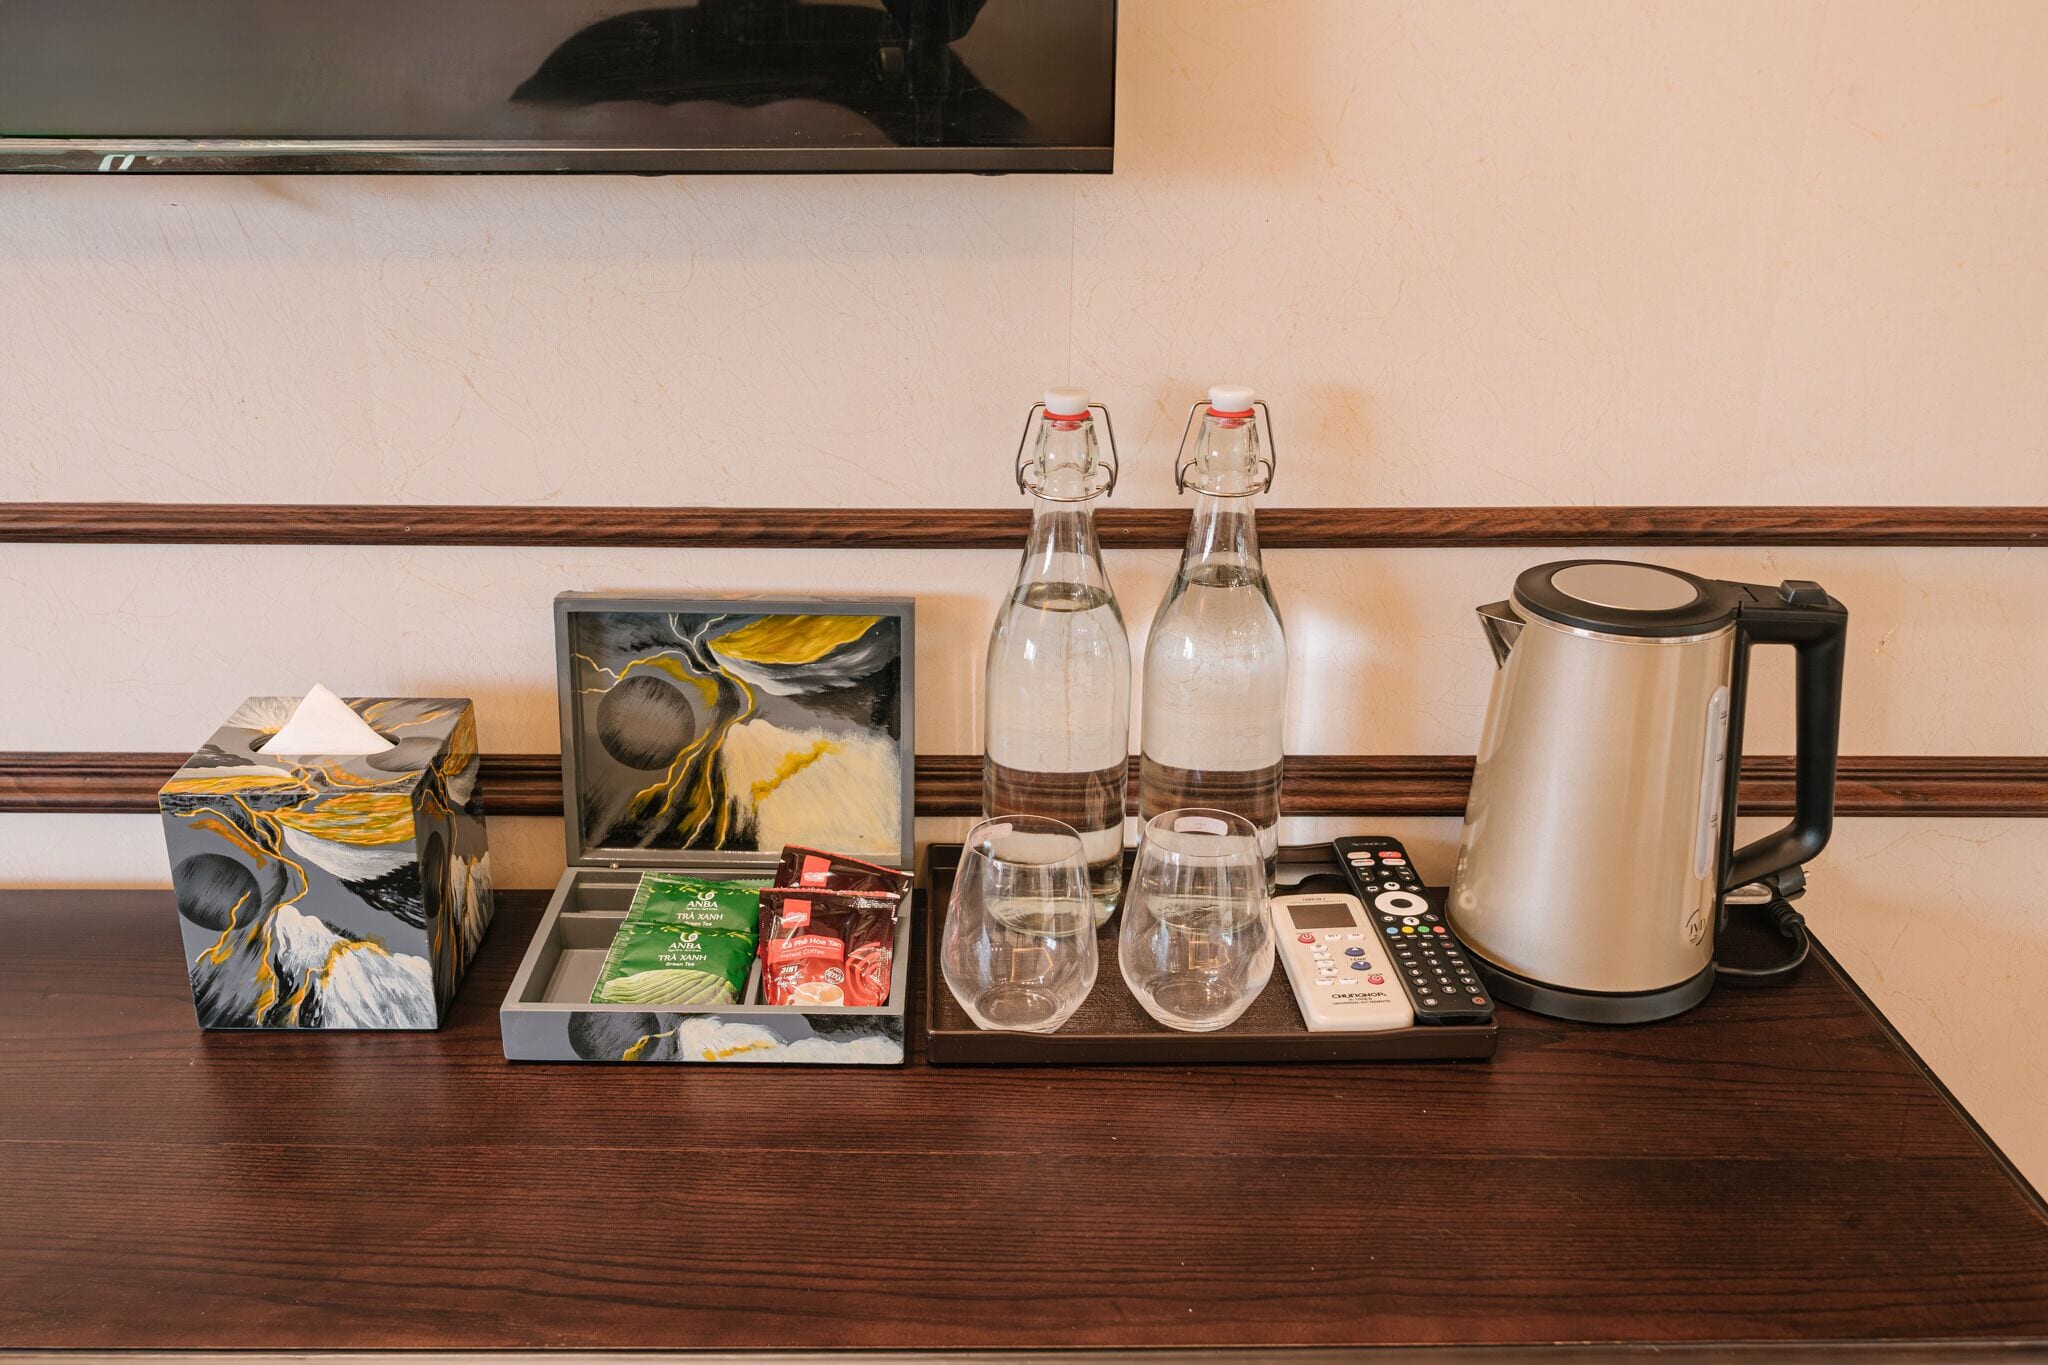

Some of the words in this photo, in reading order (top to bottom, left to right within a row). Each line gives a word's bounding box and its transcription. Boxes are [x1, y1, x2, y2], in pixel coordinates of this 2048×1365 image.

[676, 912, 695, 920] TRÀ
[829, 940, 842, 948] Tan
[658, 953, 677, 961] TRÀ
